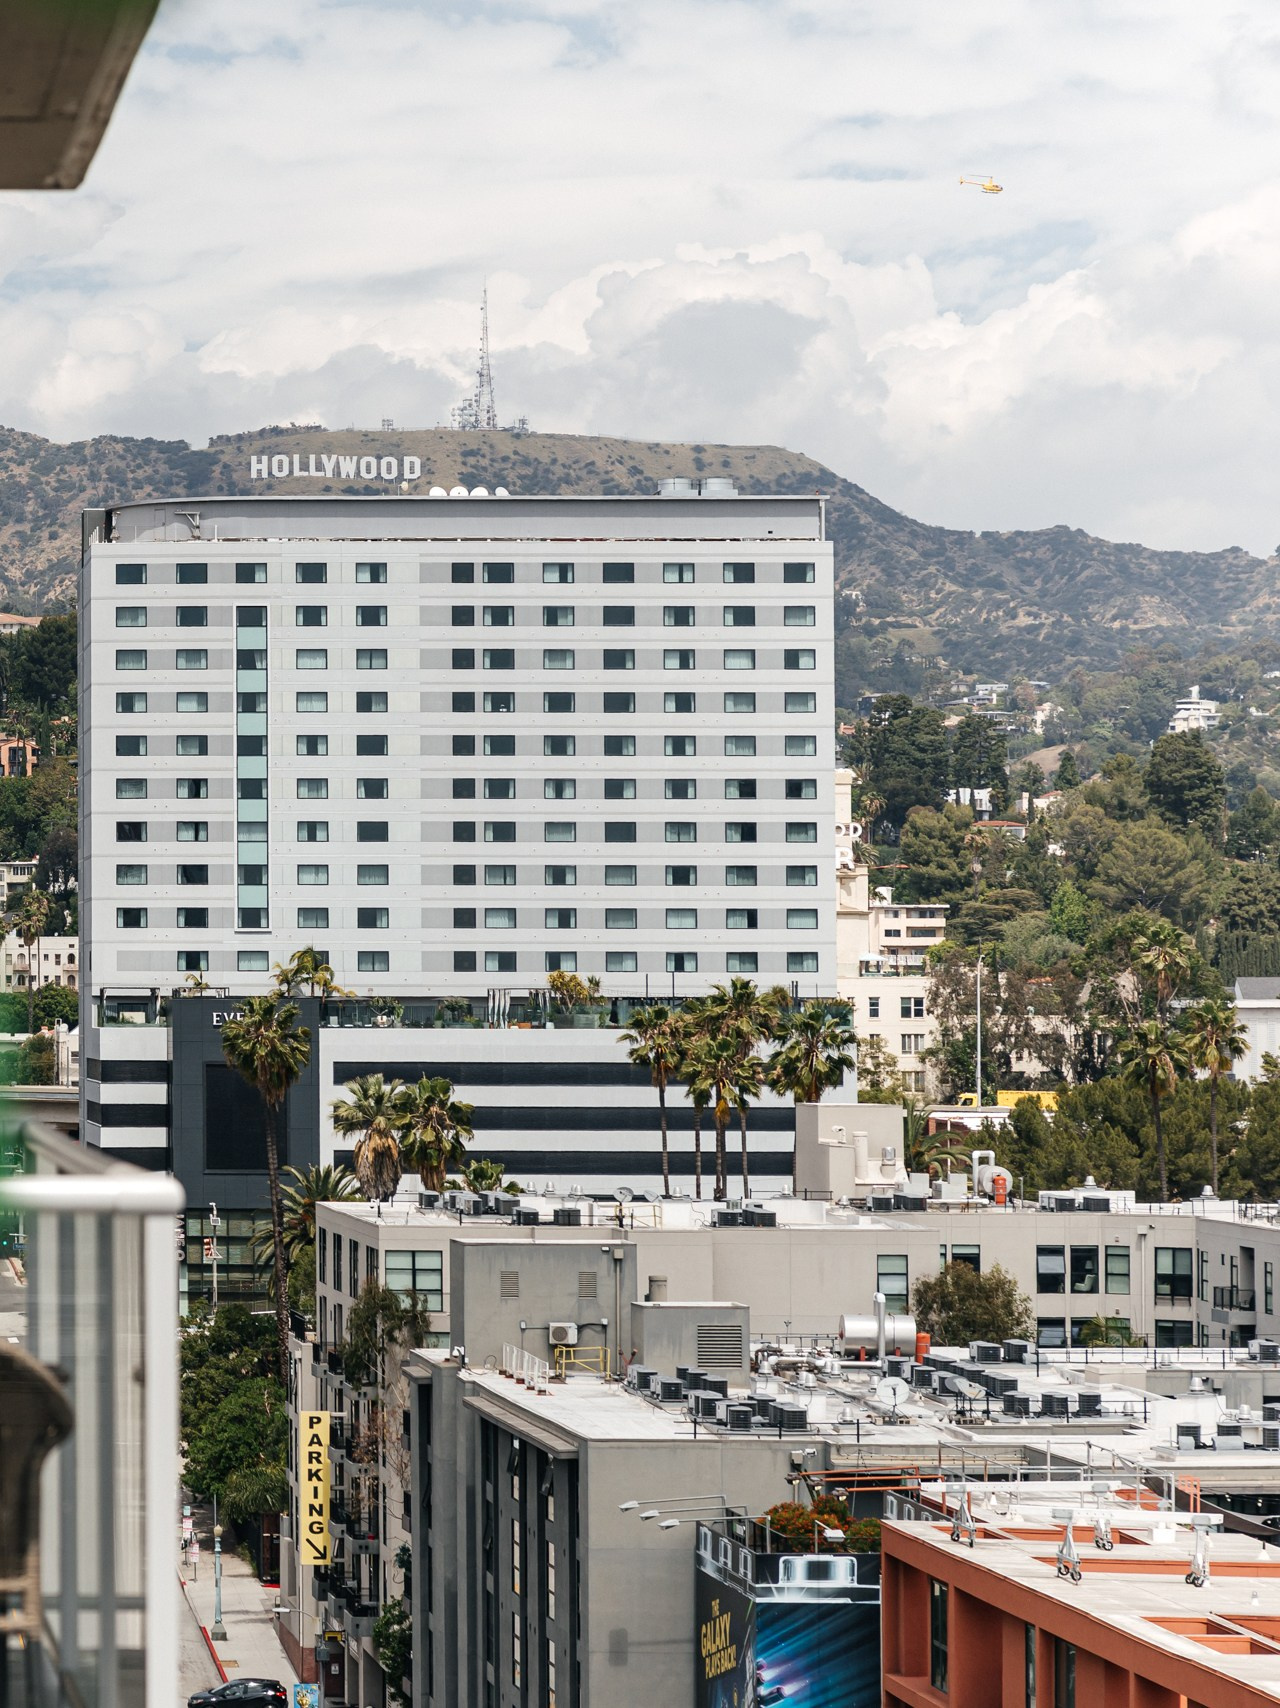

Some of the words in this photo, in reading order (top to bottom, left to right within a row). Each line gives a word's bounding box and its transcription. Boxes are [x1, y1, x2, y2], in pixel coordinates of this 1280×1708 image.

[250, 454, 421, 479] HOLLYWOOD
[307, 1416, 324, 1535] PARKING
[701, 1612, 731, 1658] GALAXY
